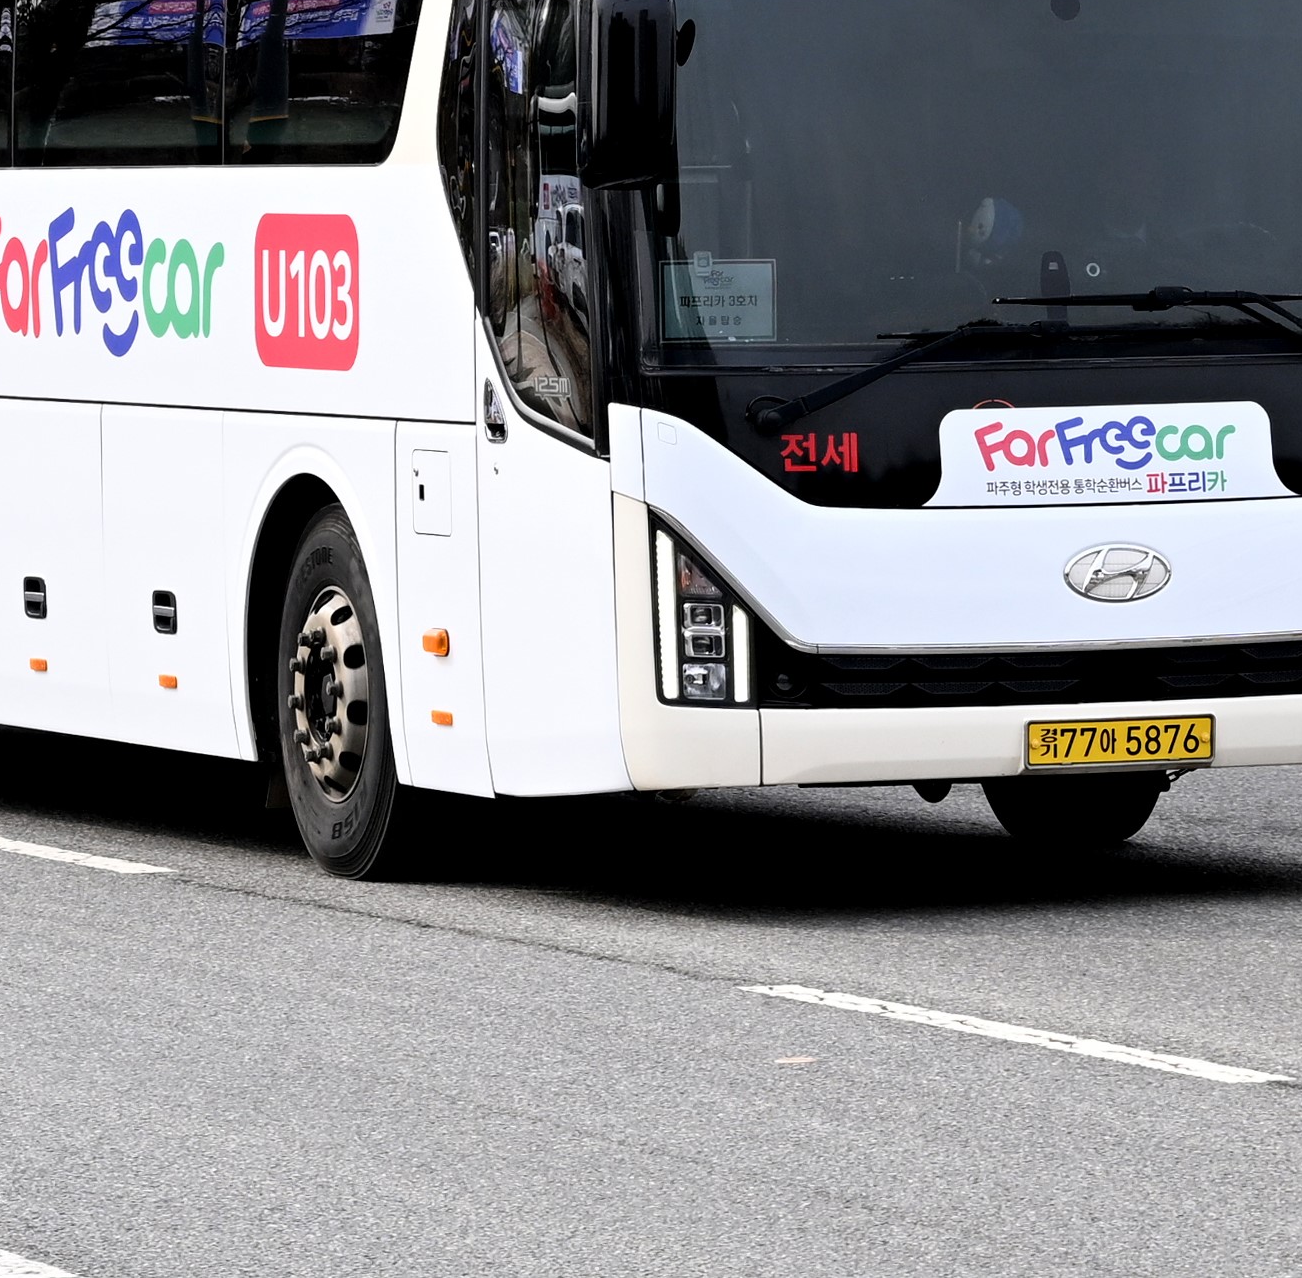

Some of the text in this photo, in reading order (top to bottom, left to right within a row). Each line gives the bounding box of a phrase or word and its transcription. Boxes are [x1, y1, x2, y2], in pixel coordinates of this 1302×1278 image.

[260, 248, 355, 341] U103
[780, 432, 860, 474] 전세
[985, 469, 1228, 497] 파주형 학생전용 통학순환버스 파프리카
[1125, 723, 1201, 757] 5876
